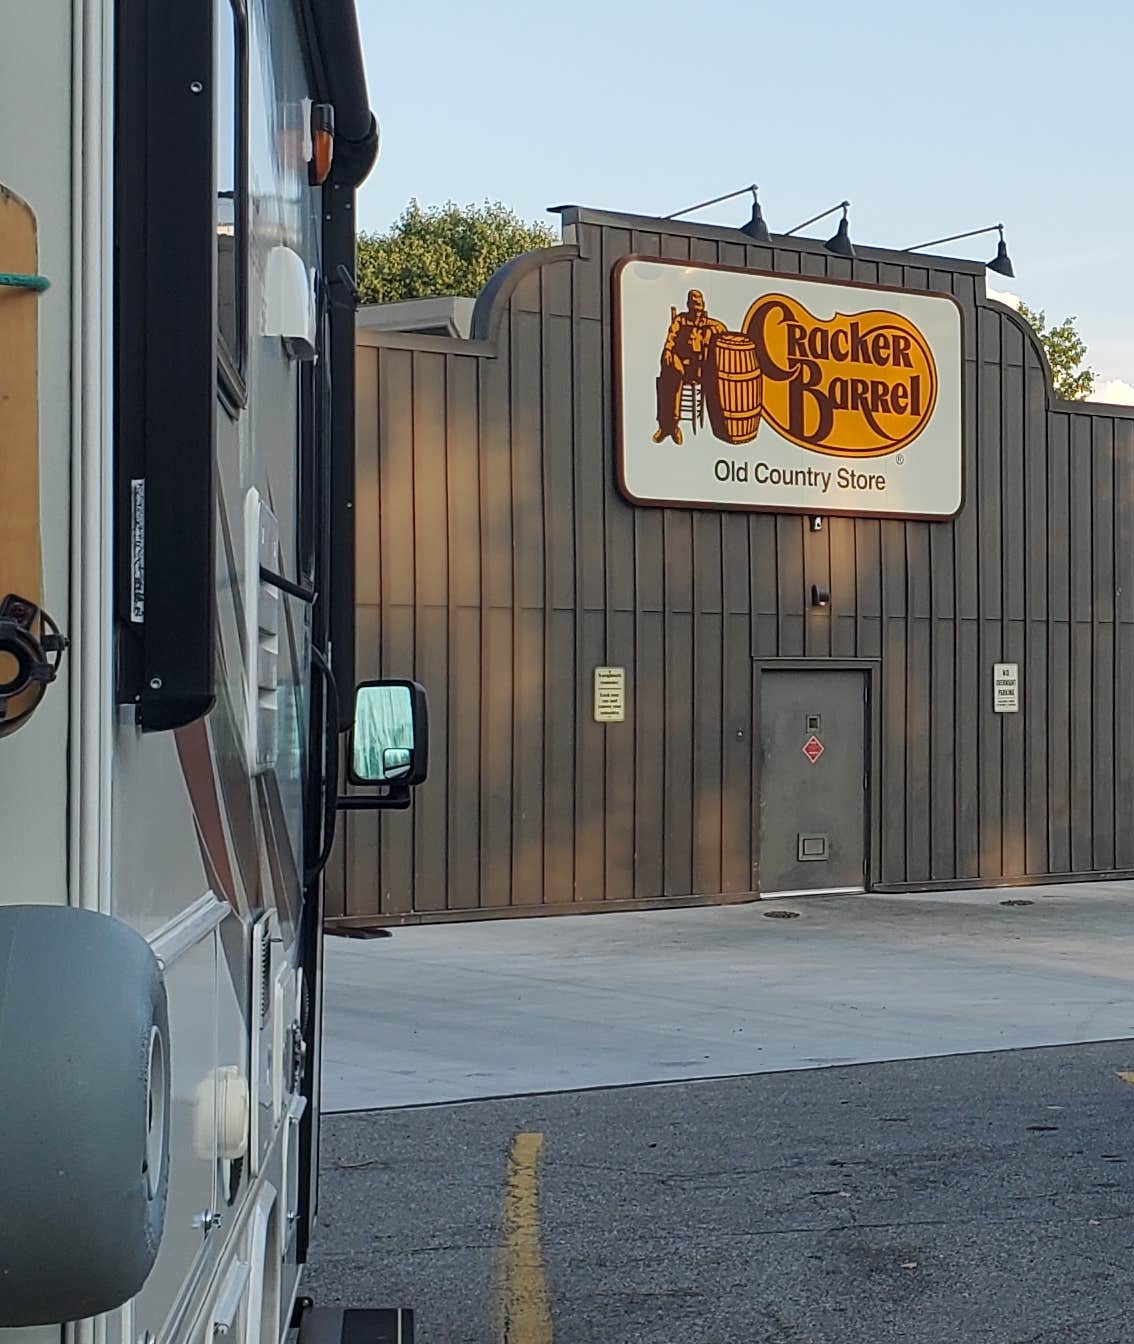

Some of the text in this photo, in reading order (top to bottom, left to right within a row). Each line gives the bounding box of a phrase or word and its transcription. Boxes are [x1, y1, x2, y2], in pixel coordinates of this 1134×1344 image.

[746, 299, 914, 381] Cracker
[786, 357, 921, 443] Barrel
[714, 459, 886, 493] Old Country Store
